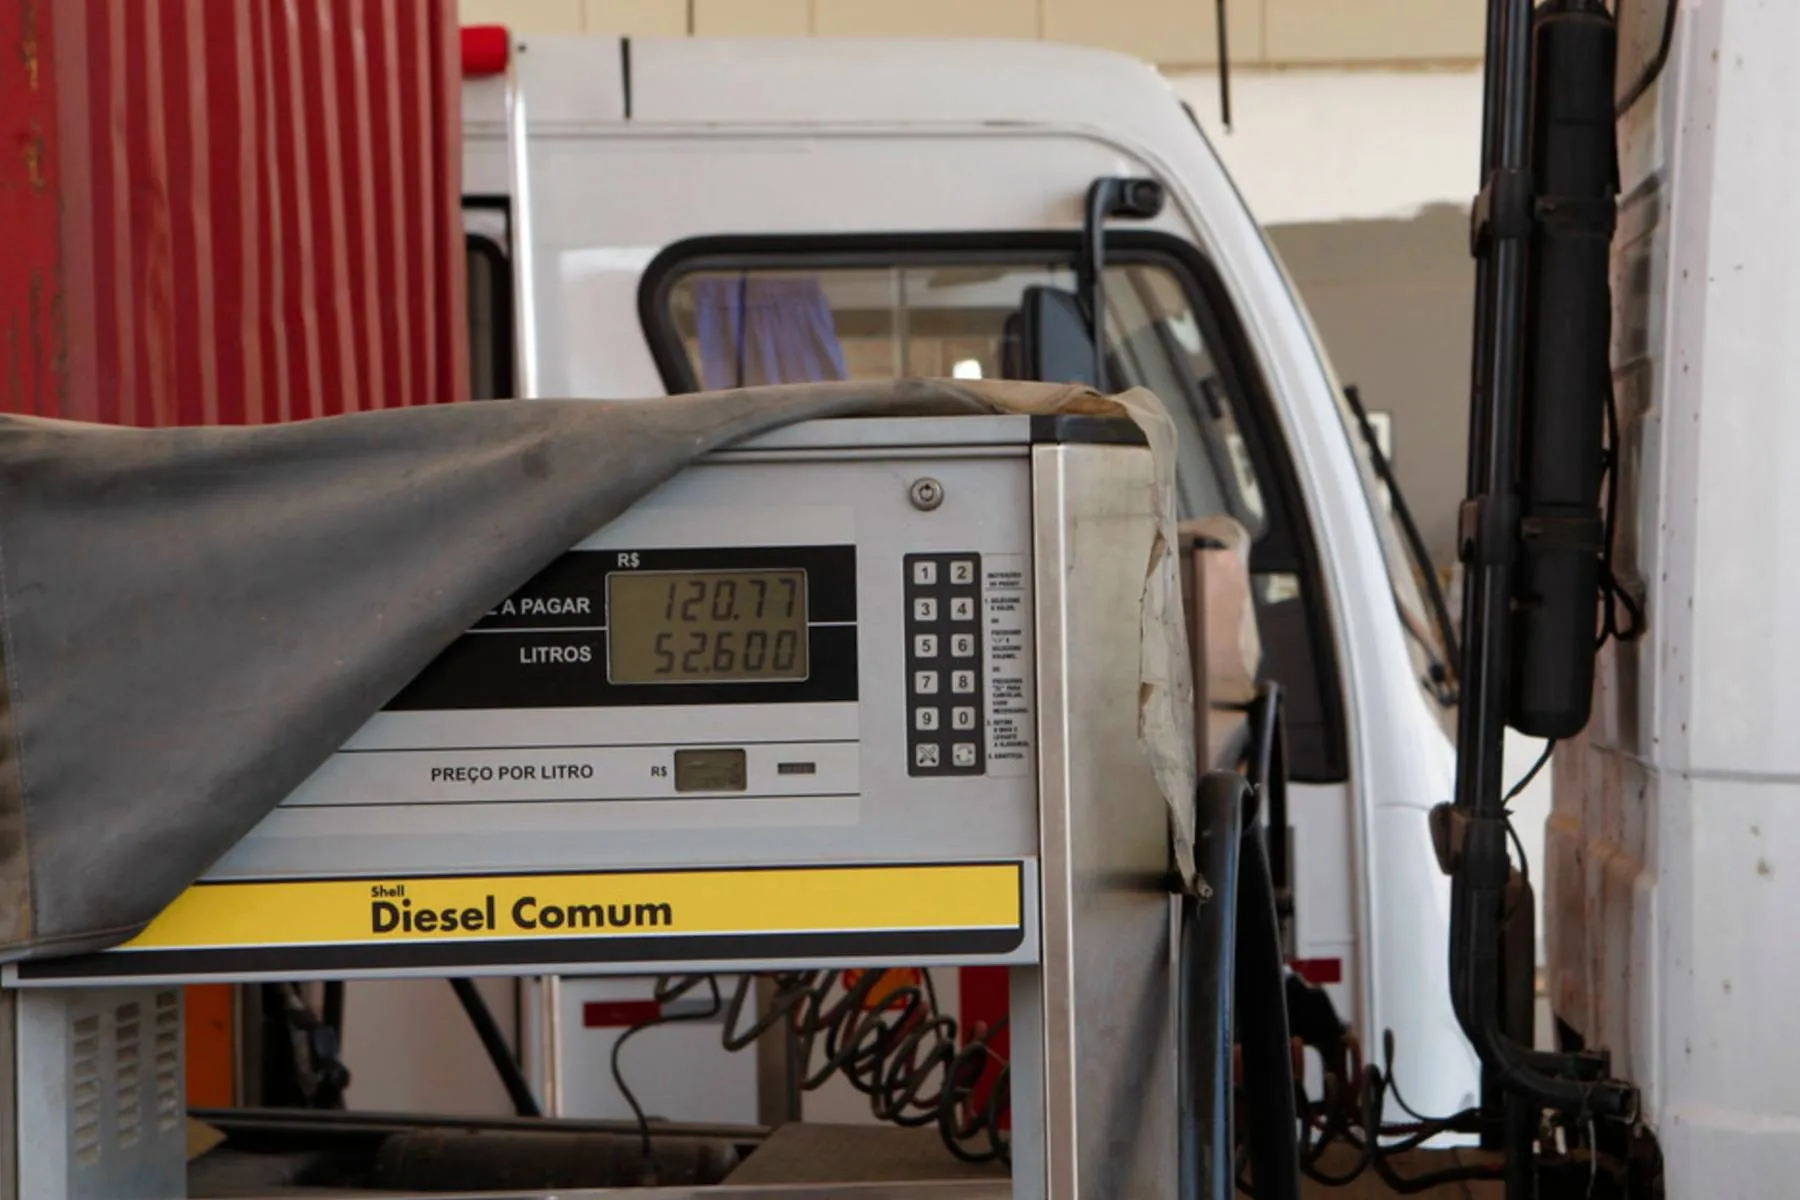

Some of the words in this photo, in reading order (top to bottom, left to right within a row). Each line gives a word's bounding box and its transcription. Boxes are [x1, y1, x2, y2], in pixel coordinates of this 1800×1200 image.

[617, 552, 640, 568] R$
[921, 566, 929, 579] 1
[957, 566, 967, 579] 2
[501, 598, 516, 615] A
[521, 597, 592, 615] PAGAR
[665, 577, 797, 621] 120.77
[921, 602, 930, 616] 3
[957, 602, 967, 616] 4
[654, 629, 798, 674] 52.600
[922, 639, 931, 653] 5
[958, 638, 967, 652] 6
[520, 645, 592, 663] LITROS
[922, 675, 931, 689] 7
[959, 675, 968, 689] 8
[922, 711, 932, 725] 9
[960, 711, 968, 725] 0
[431, 766, 493, 784] PREÇO
[498, 765, 536, 780] POR
[541, 764, 594, 780] LITRO
[651, 765, 668, 777] R$
[371, 885, 405, 897] Shell
[372, 895, 496, 933] Diesel
[512, 896, 673, 930] Comum
